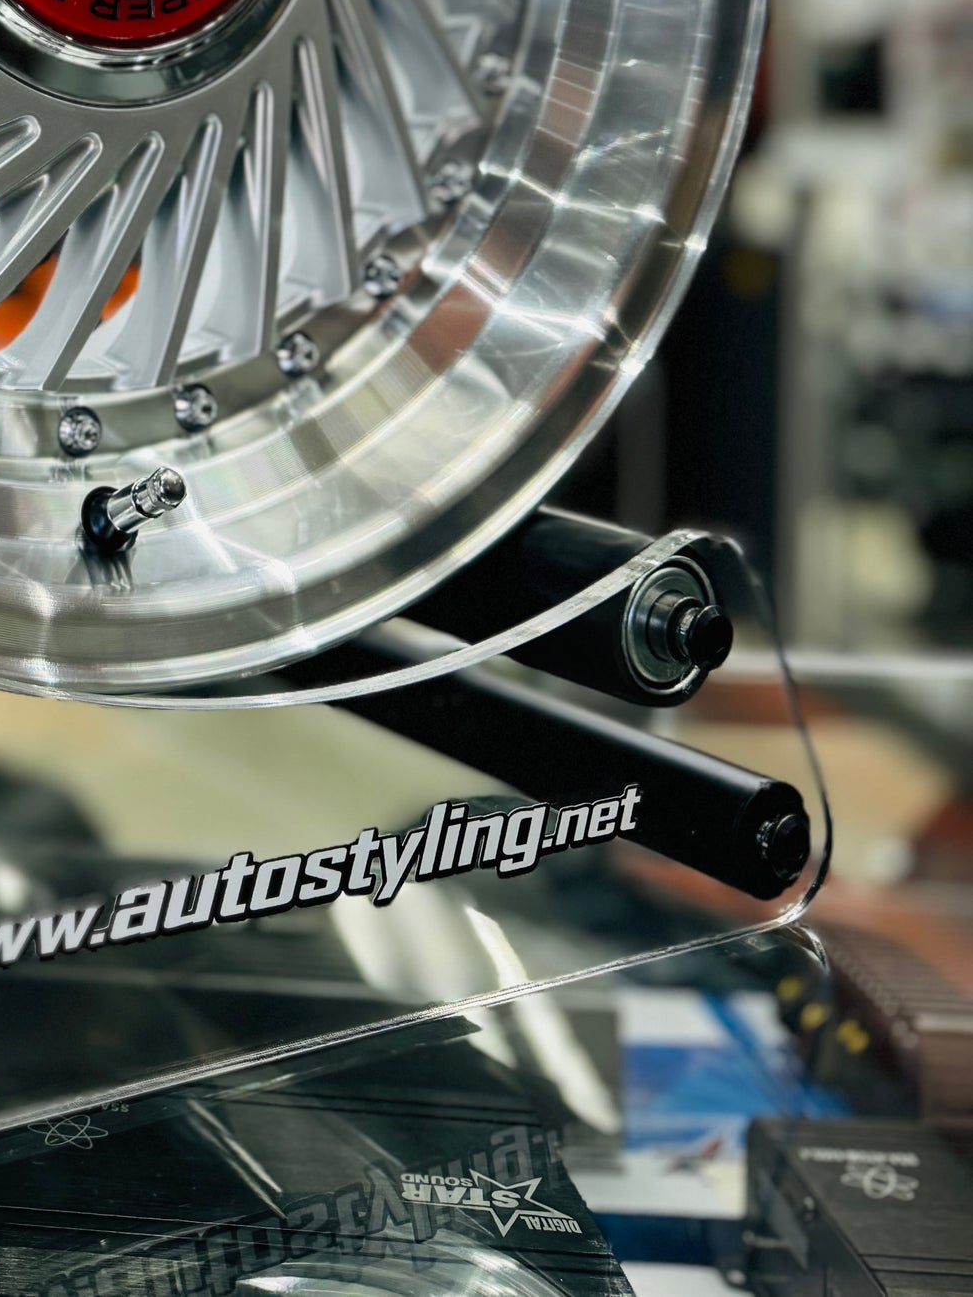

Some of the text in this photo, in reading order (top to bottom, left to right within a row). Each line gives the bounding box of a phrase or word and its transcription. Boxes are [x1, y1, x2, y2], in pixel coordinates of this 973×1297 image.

[400, 1172, 474, 1187] SOUND
[401, 1182, 522, 1208] STAR
[519, 1215, 583, 1234] DIGITAL
